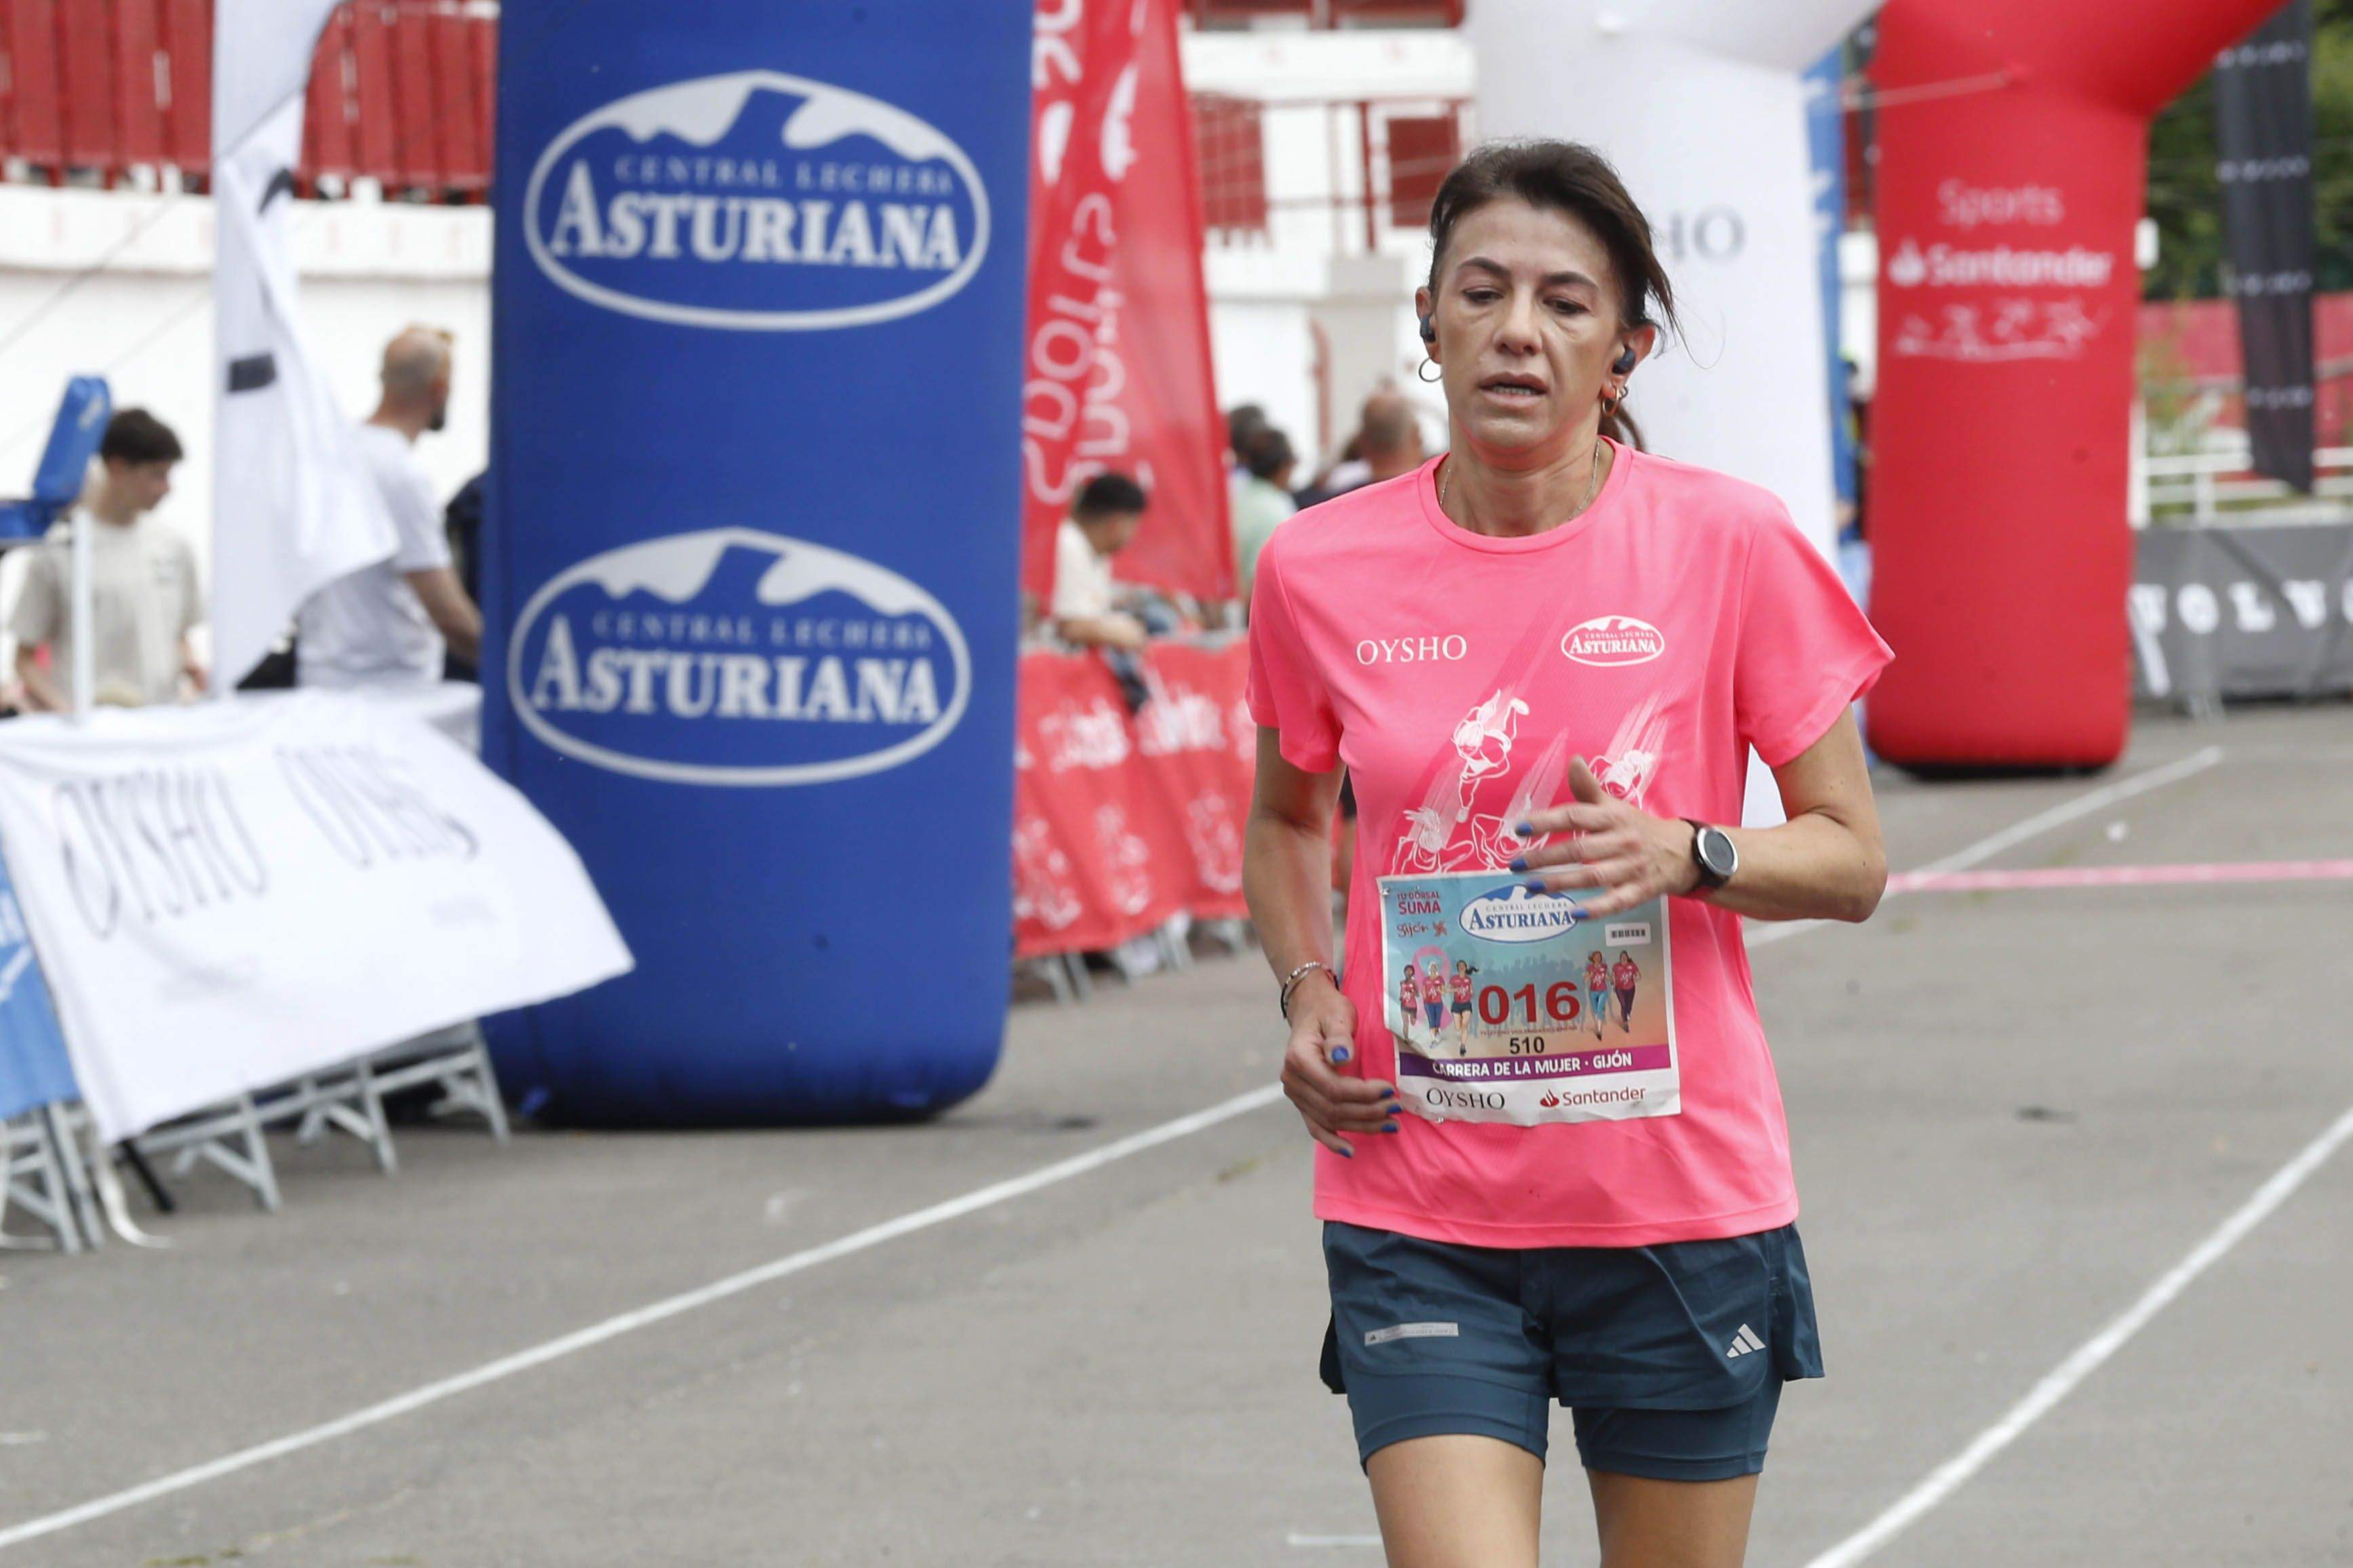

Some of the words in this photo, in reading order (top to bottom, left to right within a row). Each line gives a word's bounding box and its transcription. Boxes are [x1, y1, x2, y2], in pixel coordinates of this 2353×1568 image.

[614, 155, 782, 188] CENTRAL
[796, 160, 953, 195] LECHERA
[551, 159, 963, 270] ASTURIANA
[1938, 178, 2063, 229] Sports
[1929, 243, 2113, 286] Santander
[593, 611, 754, 645] CENTRAL
[1356, 634, 1467, 665] OYSHO
[1569, 635, 1657, 654] ASTURIANA
[531, 614, 941, 723] ASTURIANA
[1398, 900, 1442, 915] SUMA
[1469, 908, 1573, 930] ASTURIANA
[1528, 902, 1568, 910] LECHERA
[1478, 981, 1580, 1024] 016
[1509, 1036, 1545, 1054] 510
[1432, 1062, 1490, 1077] CARRERA
[1494, 1062, 1510, 1076] DE
[1515, 1060, 1534, 1074] LA
[1535, 1058, 1581, 1074] MUJER
[1594, 1049, 1632, 1069] GIJÓN
[1426, 1087, 1505, 1110] OYSHO
[1562, 1087, 1646, 1106] Santander
